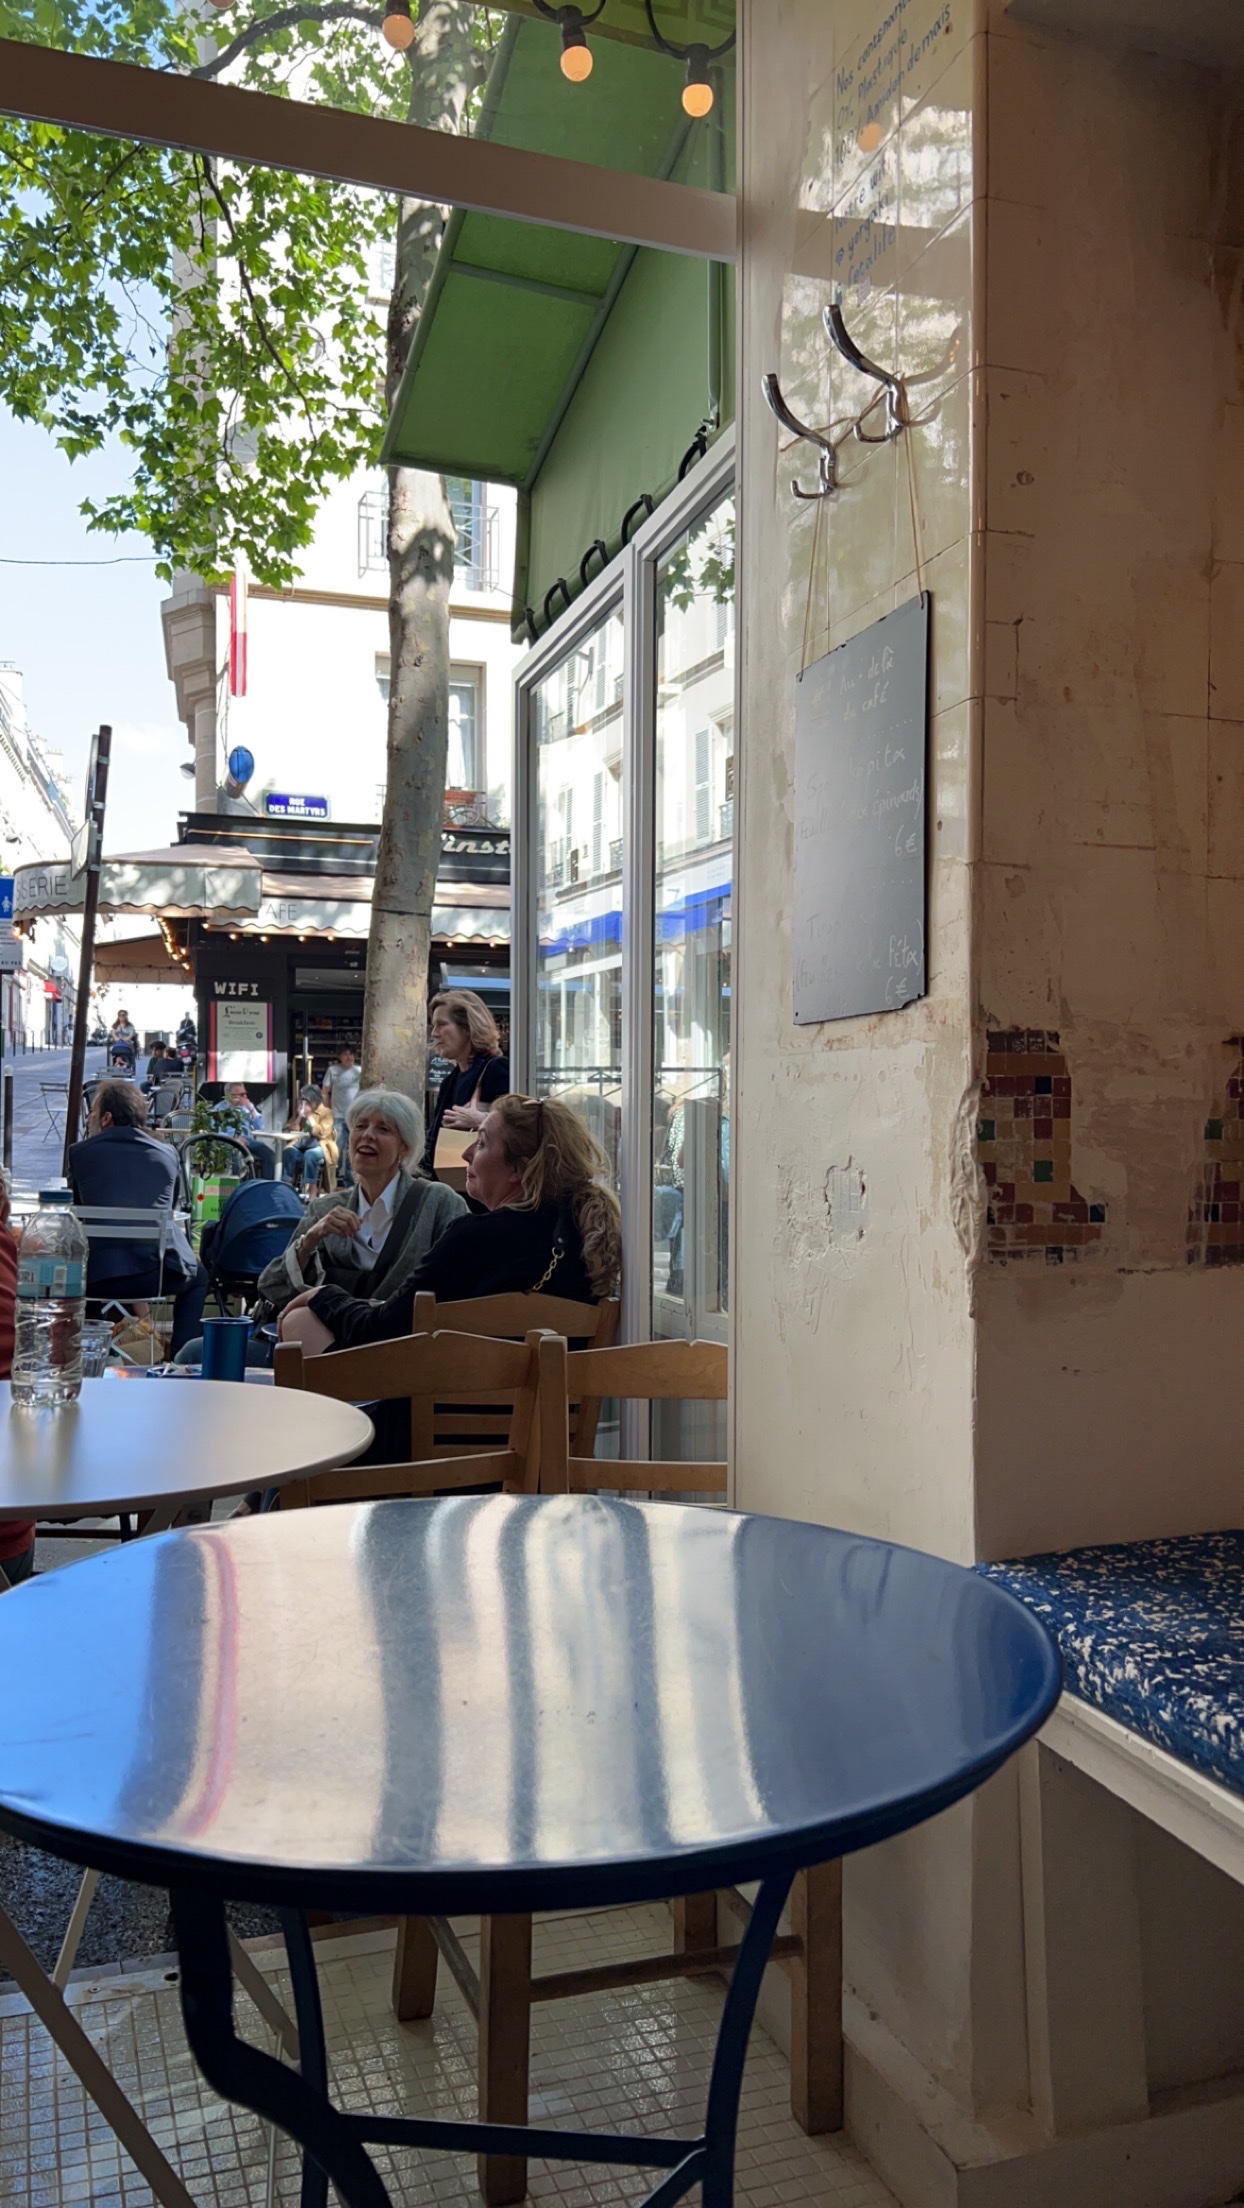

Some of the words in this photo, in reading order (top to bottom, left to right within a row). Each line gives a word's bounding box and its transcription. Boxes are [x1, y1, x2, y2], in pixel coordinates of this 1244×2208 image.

[857, 0, 911, 71] contenan
[288, 798, 306, 806] RUE
[268, 804, 286, 814] DES
[286, 806, 326, 816] MARTYRS
[263, 902, 298, 922] AFE
[214, 981, 259, 996] WIFI
